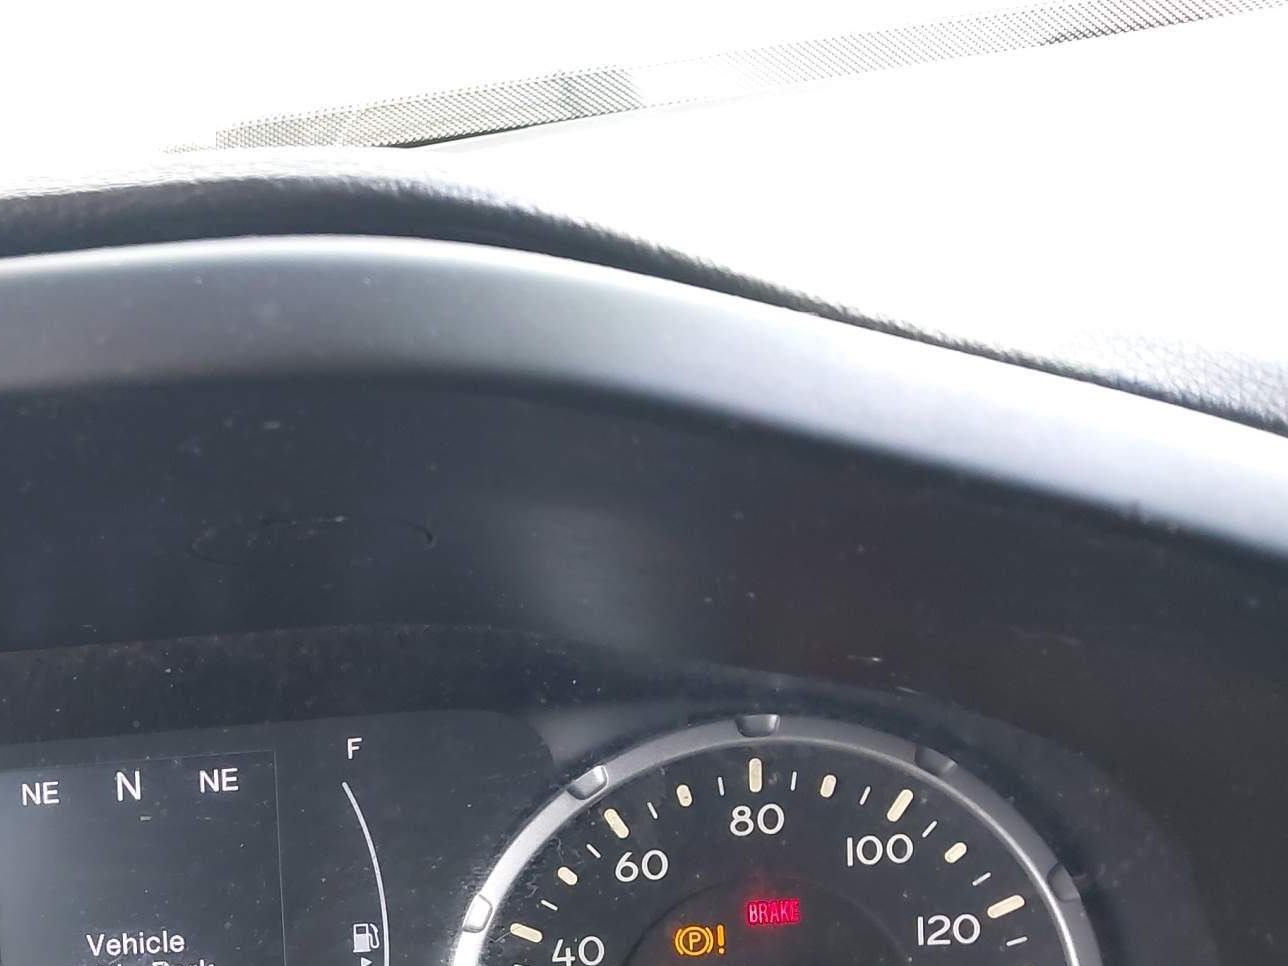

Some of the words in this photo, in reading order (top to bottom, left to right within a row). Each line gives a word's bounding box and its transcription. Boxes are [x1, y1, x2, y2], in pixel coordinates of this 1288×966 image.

[348, 738, 361, 759] F
[22, 782, 59, 805] NE
[117, 771, 140, 801] N
[200, 768, 238, 792] NE
[730, 804, 784, 836] 80
[847, 834, 913, 866] 100
[616, 850, 668, 882] 60
[748, 900, 800, 924] BRAKE
[86, 931, 185, 957] Vehicle
[918, 914, 980, 945] 120
[552, 936, 604, 966] 40
